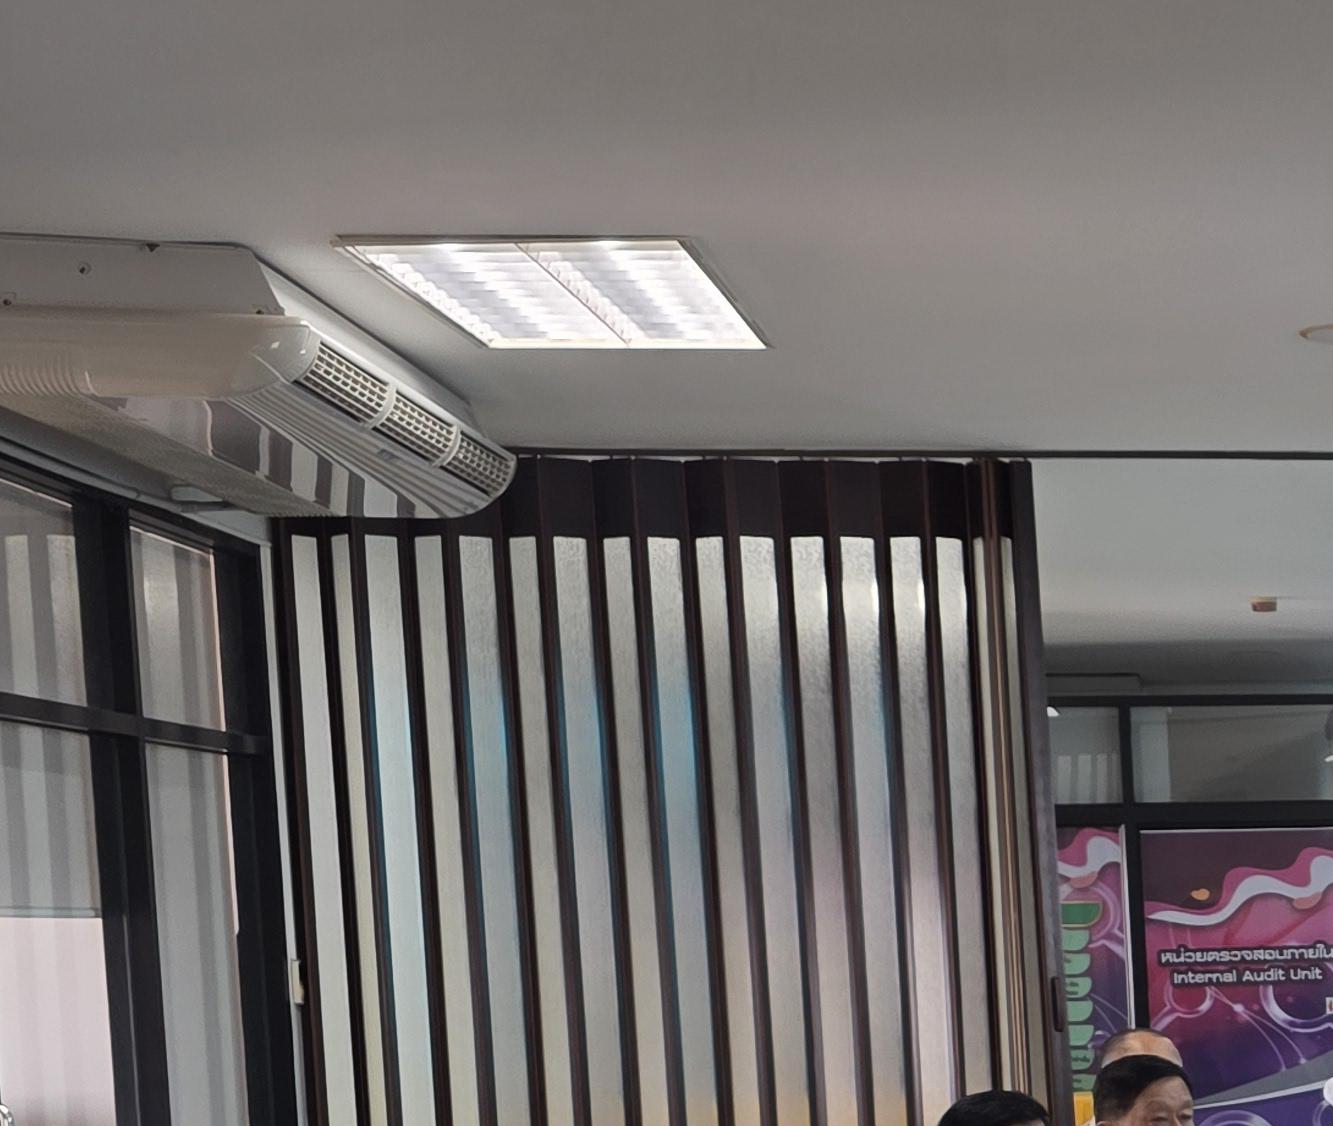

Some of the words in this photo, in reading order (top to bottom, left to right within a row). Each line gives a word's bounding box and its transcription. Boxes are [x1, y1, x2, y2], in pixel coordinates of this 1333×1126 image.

[1173, 972, 1237, 985] Internal
[1242, 968, 1287, 982] Audit
[1290, 967, 1323, 981] Unit
